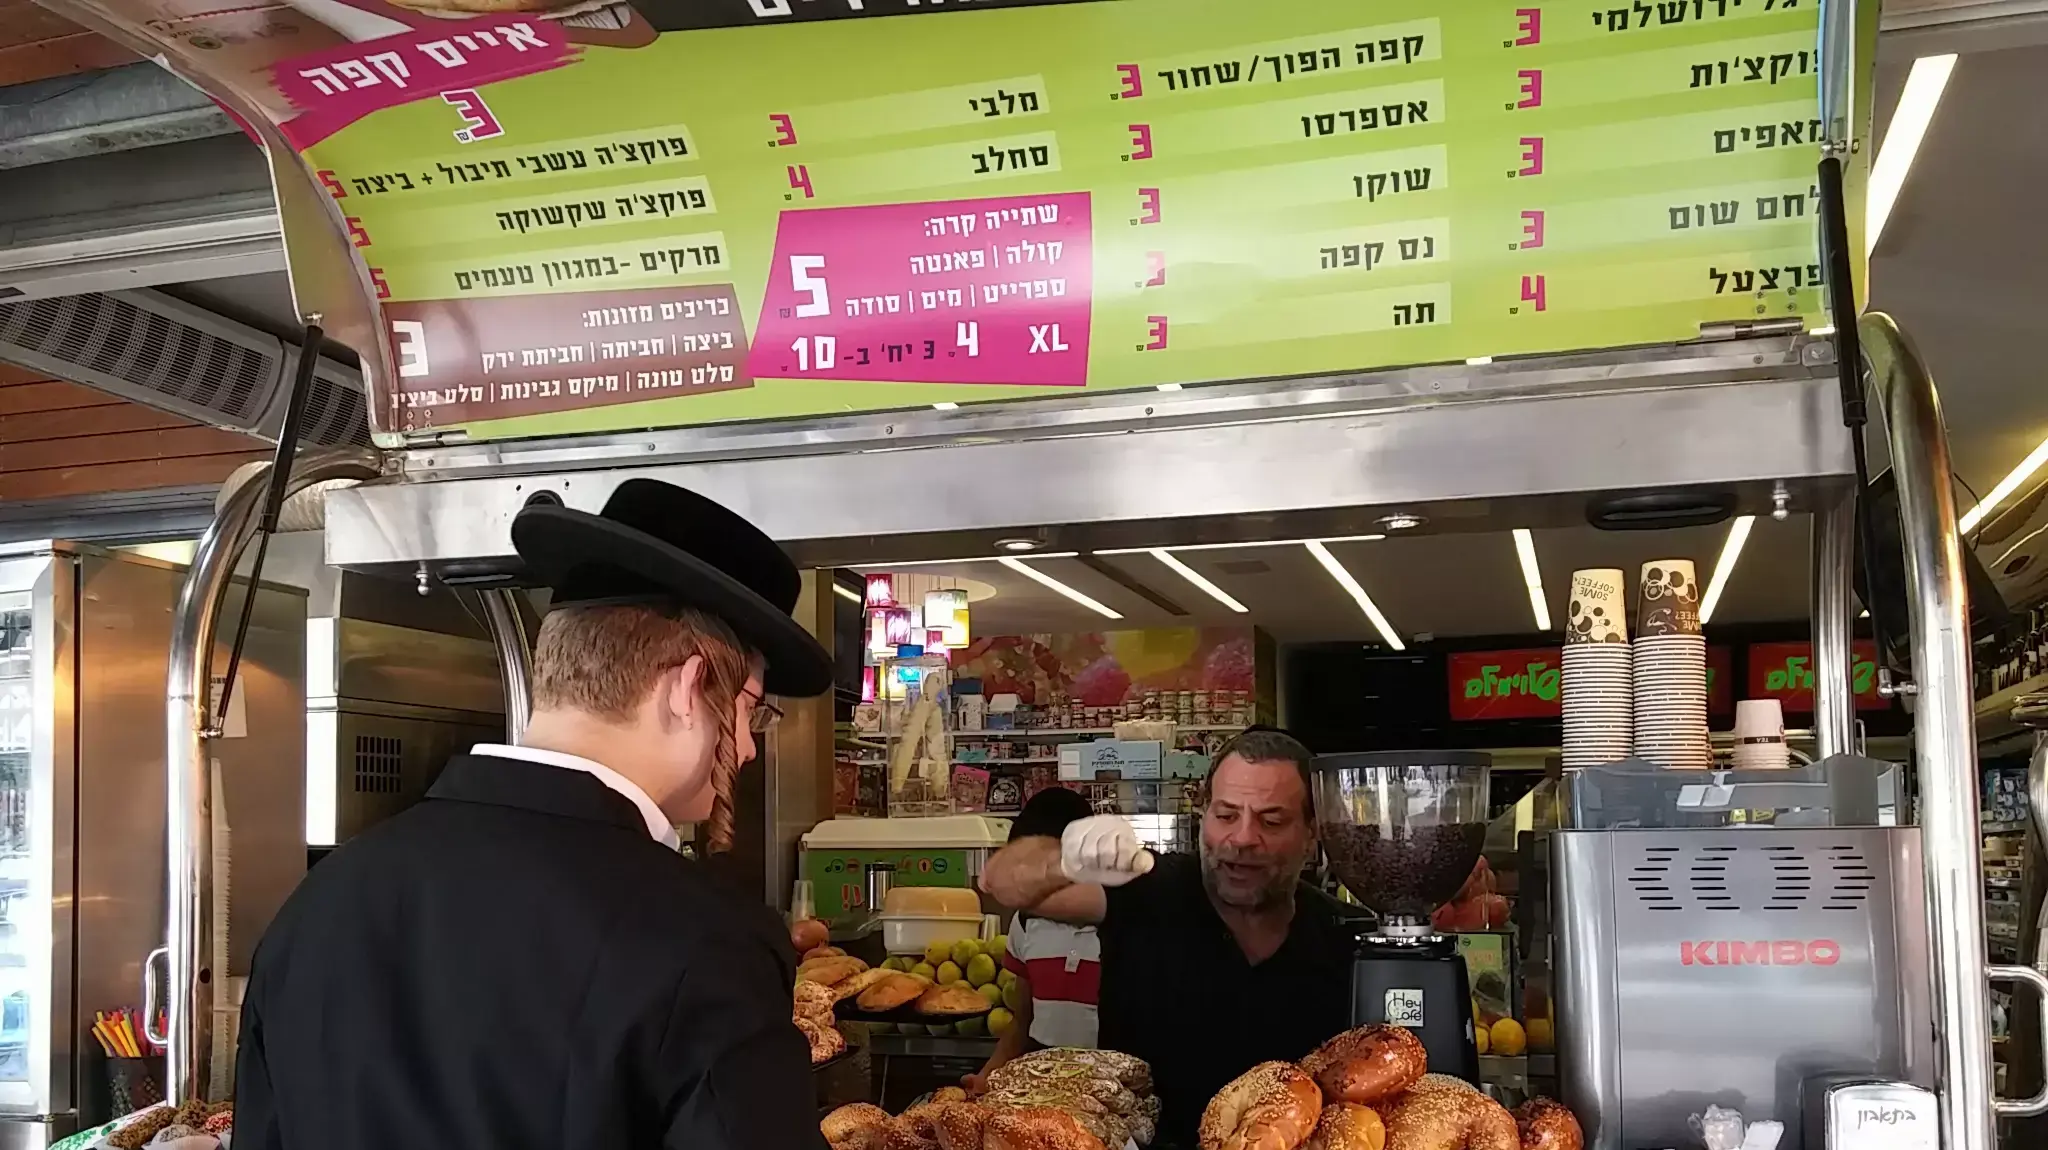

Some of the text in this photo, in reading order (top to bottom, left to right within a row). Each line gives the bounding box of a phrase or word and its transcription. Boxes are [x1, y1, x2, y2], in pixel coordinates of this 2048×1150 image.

[1515, 8, 1541, 46] 3
[300, 22, 550, 96] אייס קפה
[1355, 34, 1424, 65] קפה
[1116, 64, 1143, 99] 3
[1517, 69, 1542, 109] 3
[441, 88, 505, 140] 3
[969, 89, 1039, 117] מלבי
[768, 114, 798, 147] 3
[1301, 100, 1429, 138] אספרסו
[597, 133, 688, 167] פוקצ'ה
[1128, 124, 1153, 160] 3
[516, 149, 587, 175] עשבי
[972, 145, 1049, 174] סחלב
[1519, 137, 1543, 177] 3
[316, 170, 348, 199] 5
[352, 172, 415, 195] ביצה
[437, 158, 511, 186] תיבול
[787, 165, 815, 199] 4
[1352, 167, 1431, 202] שוקו
[345, 188, 707, 248] פוקצ'ה שקשוקה 5
[1138, 188, 1161, 224] 3
[1669, 200, 1740, 230] שום
[923, 204, 1059, 238] שתייה קרה:
[1520, 210, 1545, 250] 3
[640, 242, 722, 274] מרקים
[909, 248, 985, 275] פאנטה
[1005, 239, 1063, 266] קולה
[1319, 242, 1384, 271] קפה
[1397, 235, 1434, 261] נס
[368, 268, 392, 299] 5
[454, 267, 533, 292] טעמים
[789, 255, 831, 319] 5
[982, 277, 1067, 303] ספרייט
[1521, 275, 1546, 312] 4
[582, 296, 731, 328] כריכים מזונות:
[845, 294, 900, 318] סודה
[921, 288, 962, 310] מים
[1393, 302, 1435, 326] תה
[683, 331, 734, 353] ביצה
[956, 321, 980, 357] 4
[1028, 323, 1069, 355] XL
[1146, 316, 1167, 351] 3
[392, 320, 429, 377] 3
[482, 351, 515, 374] ירק
[522, 344, 584, 365] חביתת
[602, 337, 665, 360] חביתה
[790, 335, 836, 372] 10
[923, 340, 935, 360] 3
[500, 378, 561, 402] גבינות
[568, 374, 619, 398] מיקס
[637, 369, 684, 389] טונה
[691, 364, 734, 388] סלט
[445, 383, 484, 404] סלט
[1579, 587, 1609, 601] SOME
[1680, 940, 1840, 965] KIMBO
[1393, 992, 1421, 1012] Hey
[1858, 1106, 1916, 1130] בתאבון
